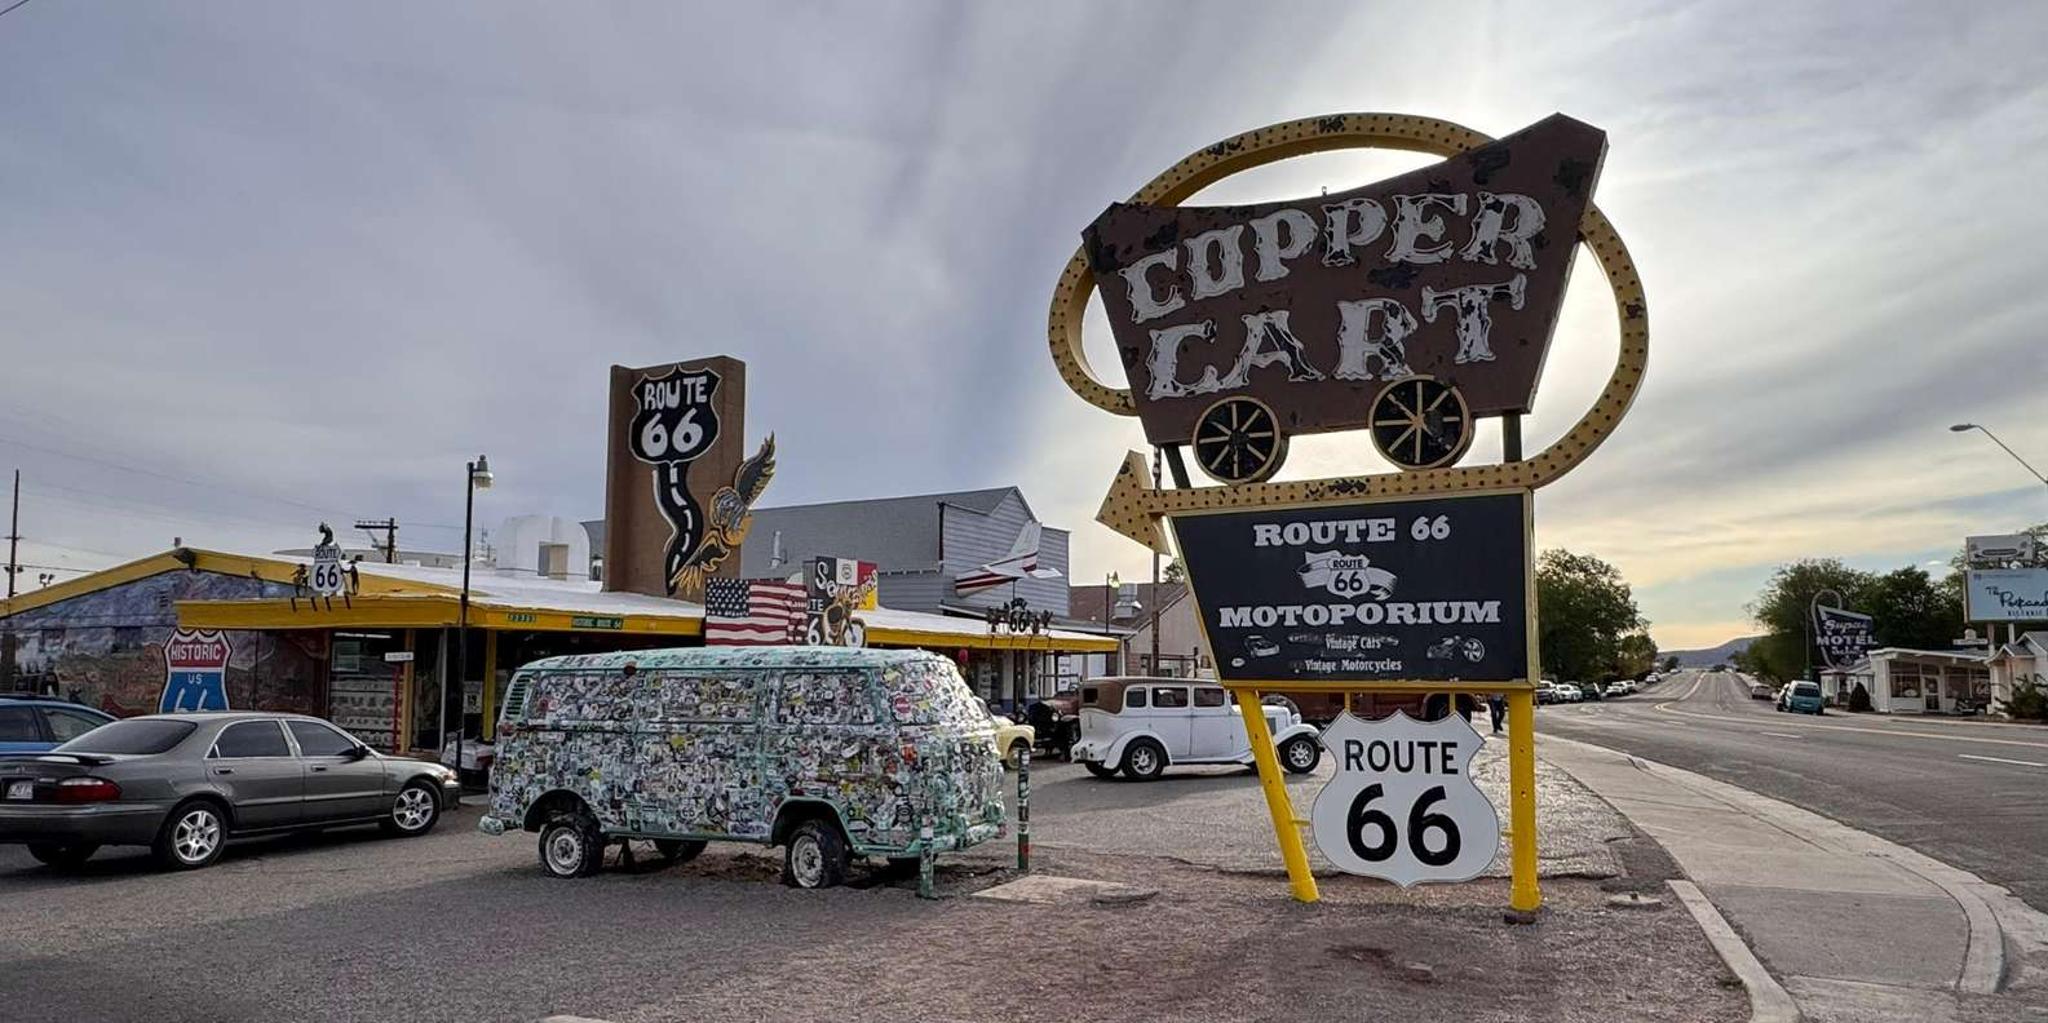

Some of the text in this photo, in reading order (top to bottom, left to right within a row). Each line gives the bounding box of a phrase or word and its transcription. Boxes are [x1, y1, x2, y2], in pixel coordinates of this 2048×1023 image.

[1118, 190, 1546, 324] COPPER
[1145, 273, 1527, 400] CART
[644, 375, 707, 411] ROUTE
[640, 407, 703, 457] 66
[1253, 514, 1450, 547] ROUTE 66
[1333, 559, 1363, 568] ROUTE
[315, 564, 338, 588] 66
[1334, 571, 1363, 592] 66
[1010, 611, 1026, 632] 66
[1219, 601, 1501, 628] MOTOPORIUM
[171, 644, 221, 660] HISTORIC
[1326, 636, 1382, 652] Vintage Cars
[1816, 635, 1879, 646] MOTEL
[1305, 657, 1403, 674] Vintage Motorcycles
[187, 673, 203, 685] US
[1344, 739, 1459, 775] ROUTE
[1346, 783, 1461, 867] 66
